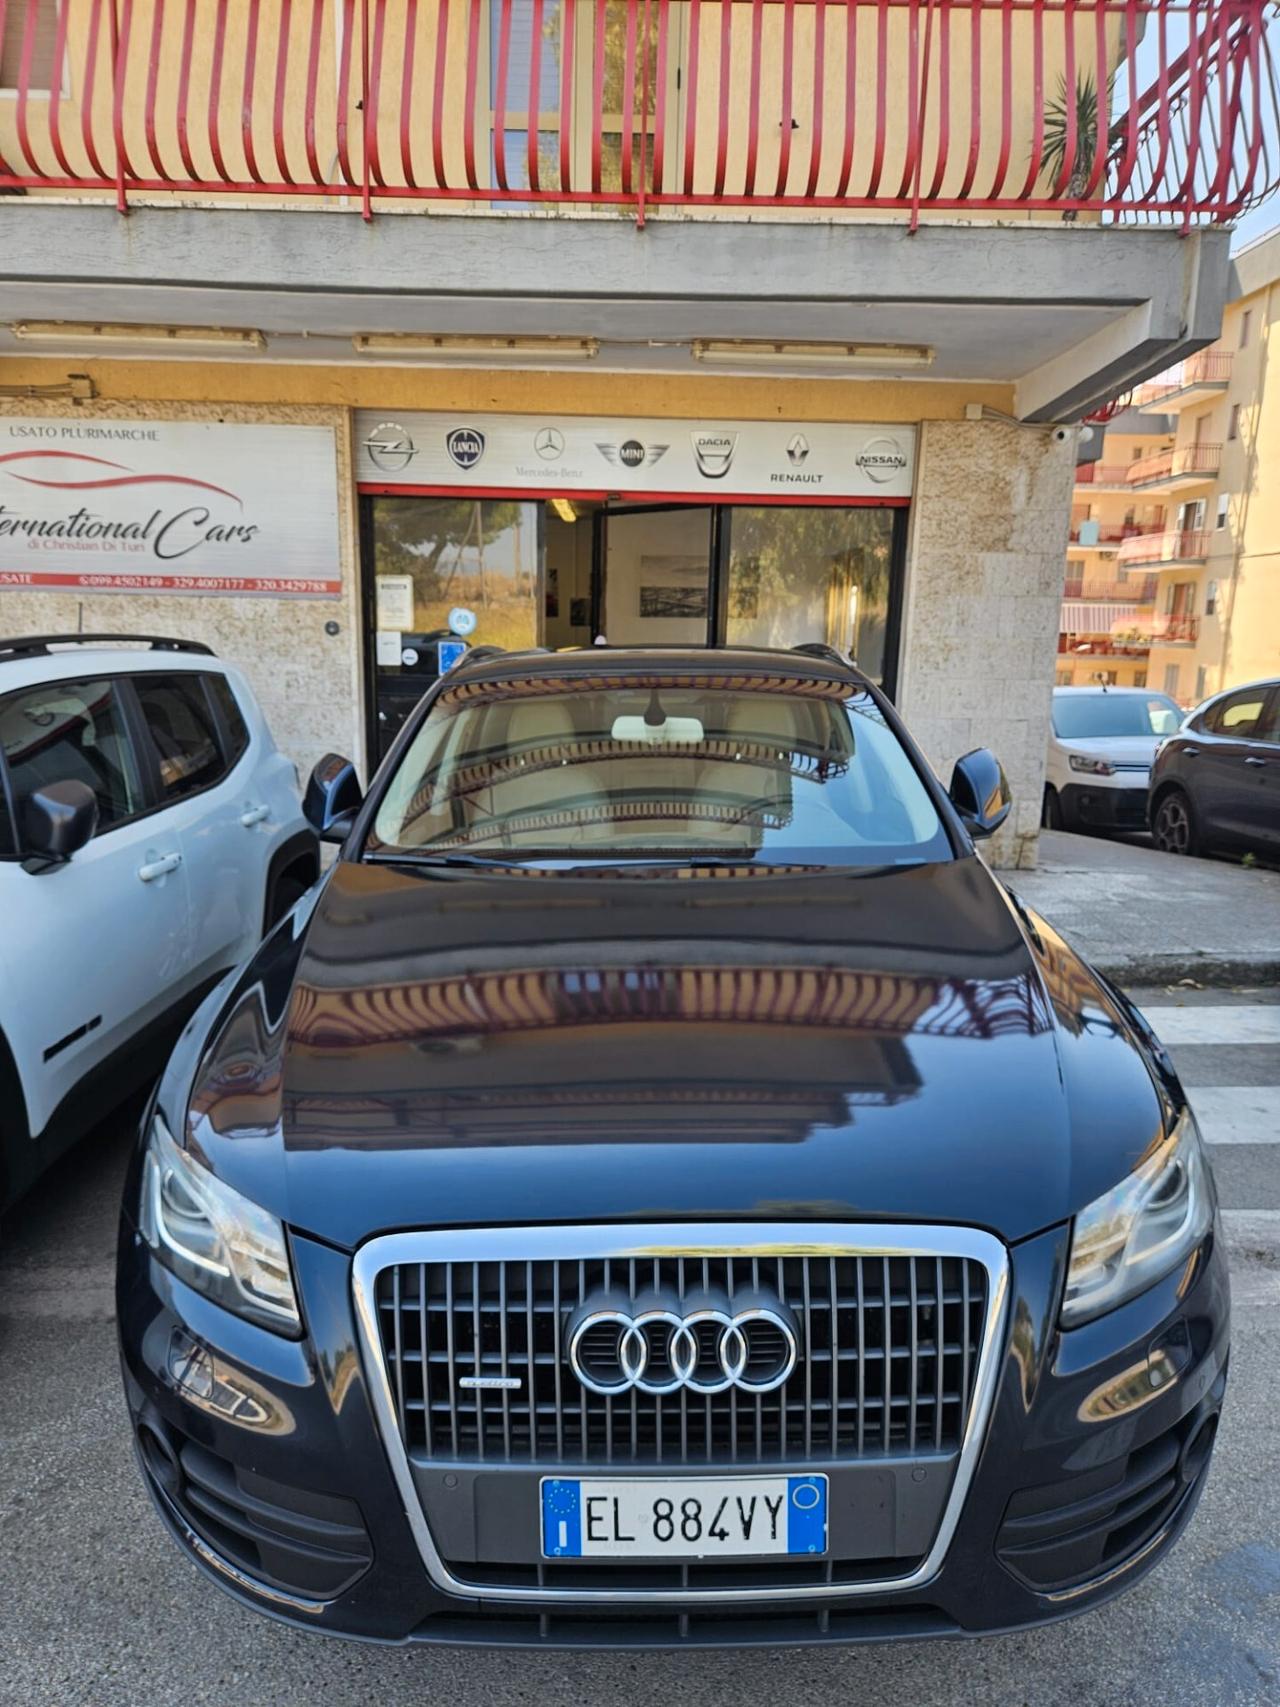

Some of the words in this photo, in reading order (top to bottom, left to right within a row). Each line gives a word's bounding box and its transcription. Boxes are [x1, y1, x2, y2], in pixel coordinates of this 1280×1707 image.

[9, 426, 57, 438] USATO
[61, 428, 160, 441] PLURIMARCHE
[453, 442, 480, 453] LANCIA
[698, 438, 731, 446] DACIA
[620, 448, 645, 459] MINI
[860, 455, 903, 464] NISSAN
[515, 467, 583, 478] Mercedes-Benz
[770, 474, 823, 483] RENAULT
[154, 507, 260, 559] Cars
[586, 1496, 636, 1542] EL
[652, 1494, 785, 1542] 884VY
